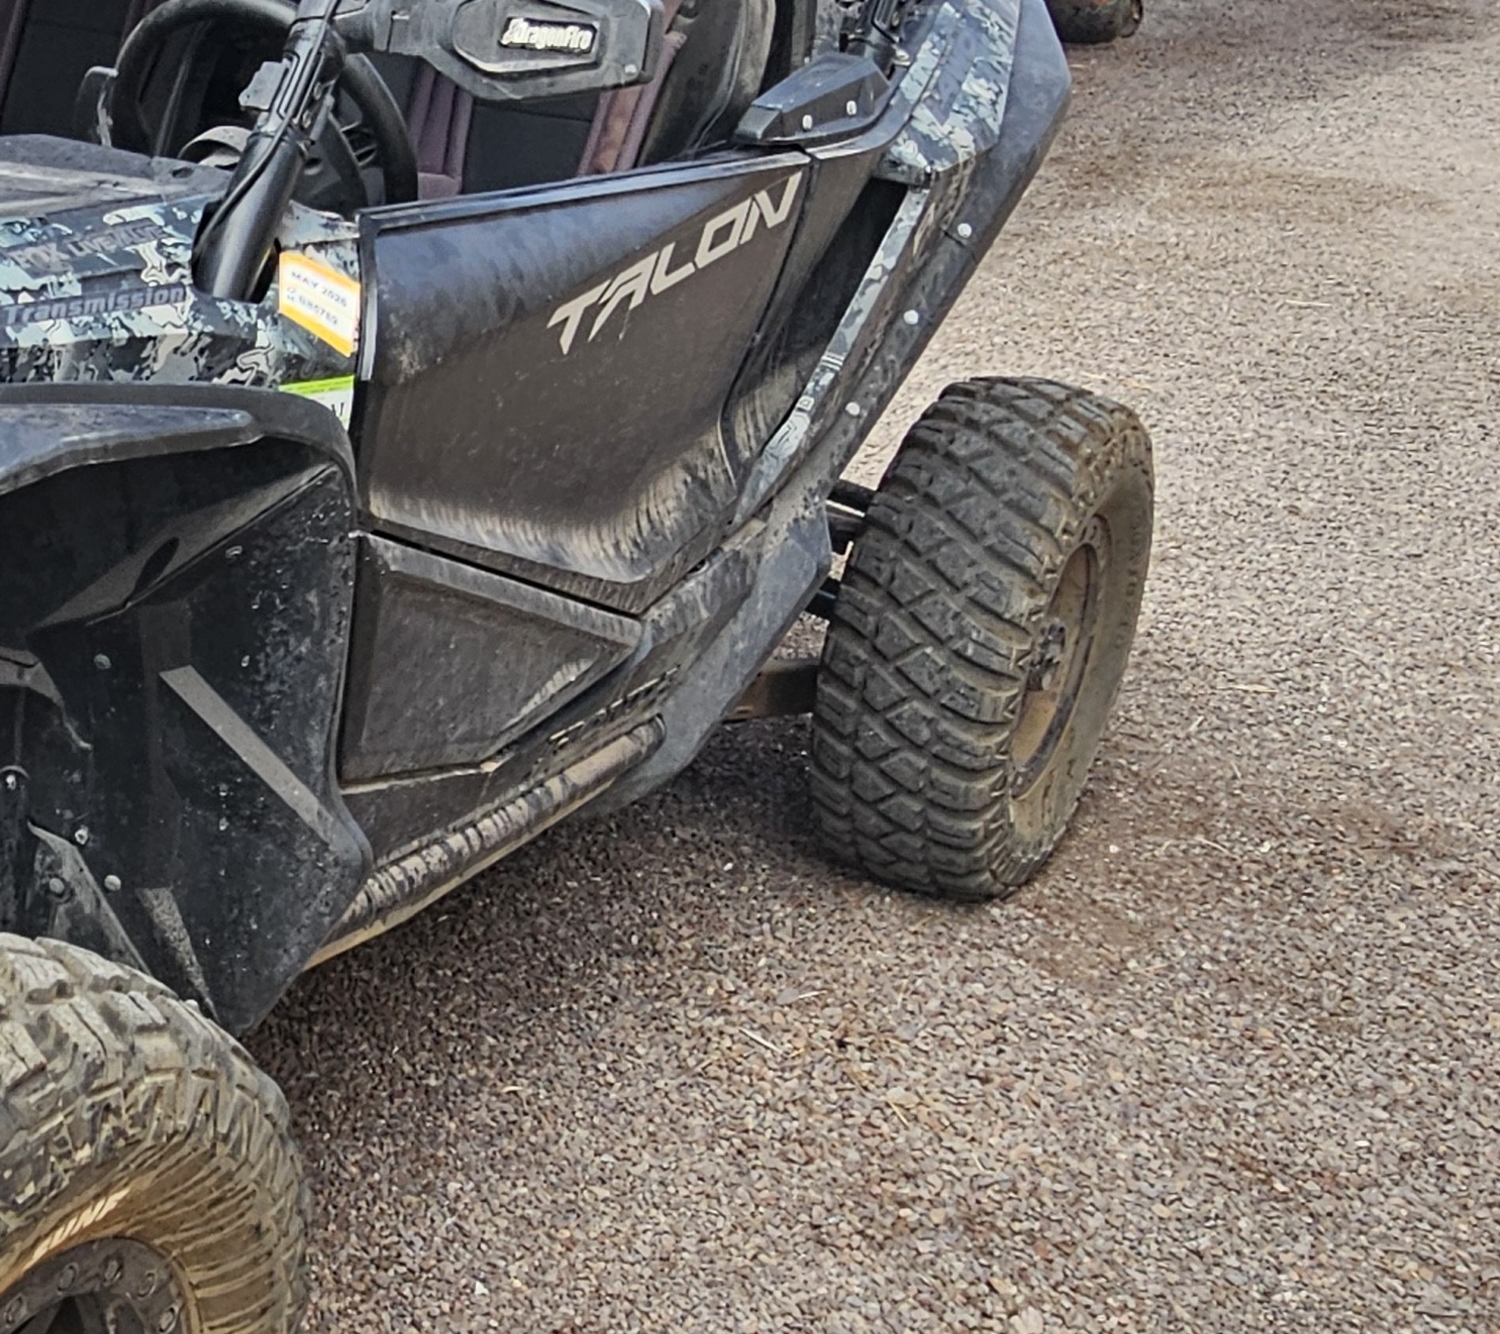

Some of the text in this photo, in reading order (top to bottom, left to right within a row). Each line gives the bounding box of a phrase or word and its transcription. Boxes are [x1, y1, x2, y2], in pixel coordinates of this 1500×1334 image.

[10, 242, 70, 268] FOX
[547, 171, 802, 355] TALON
[3, 285, 185, 325] Transmission
